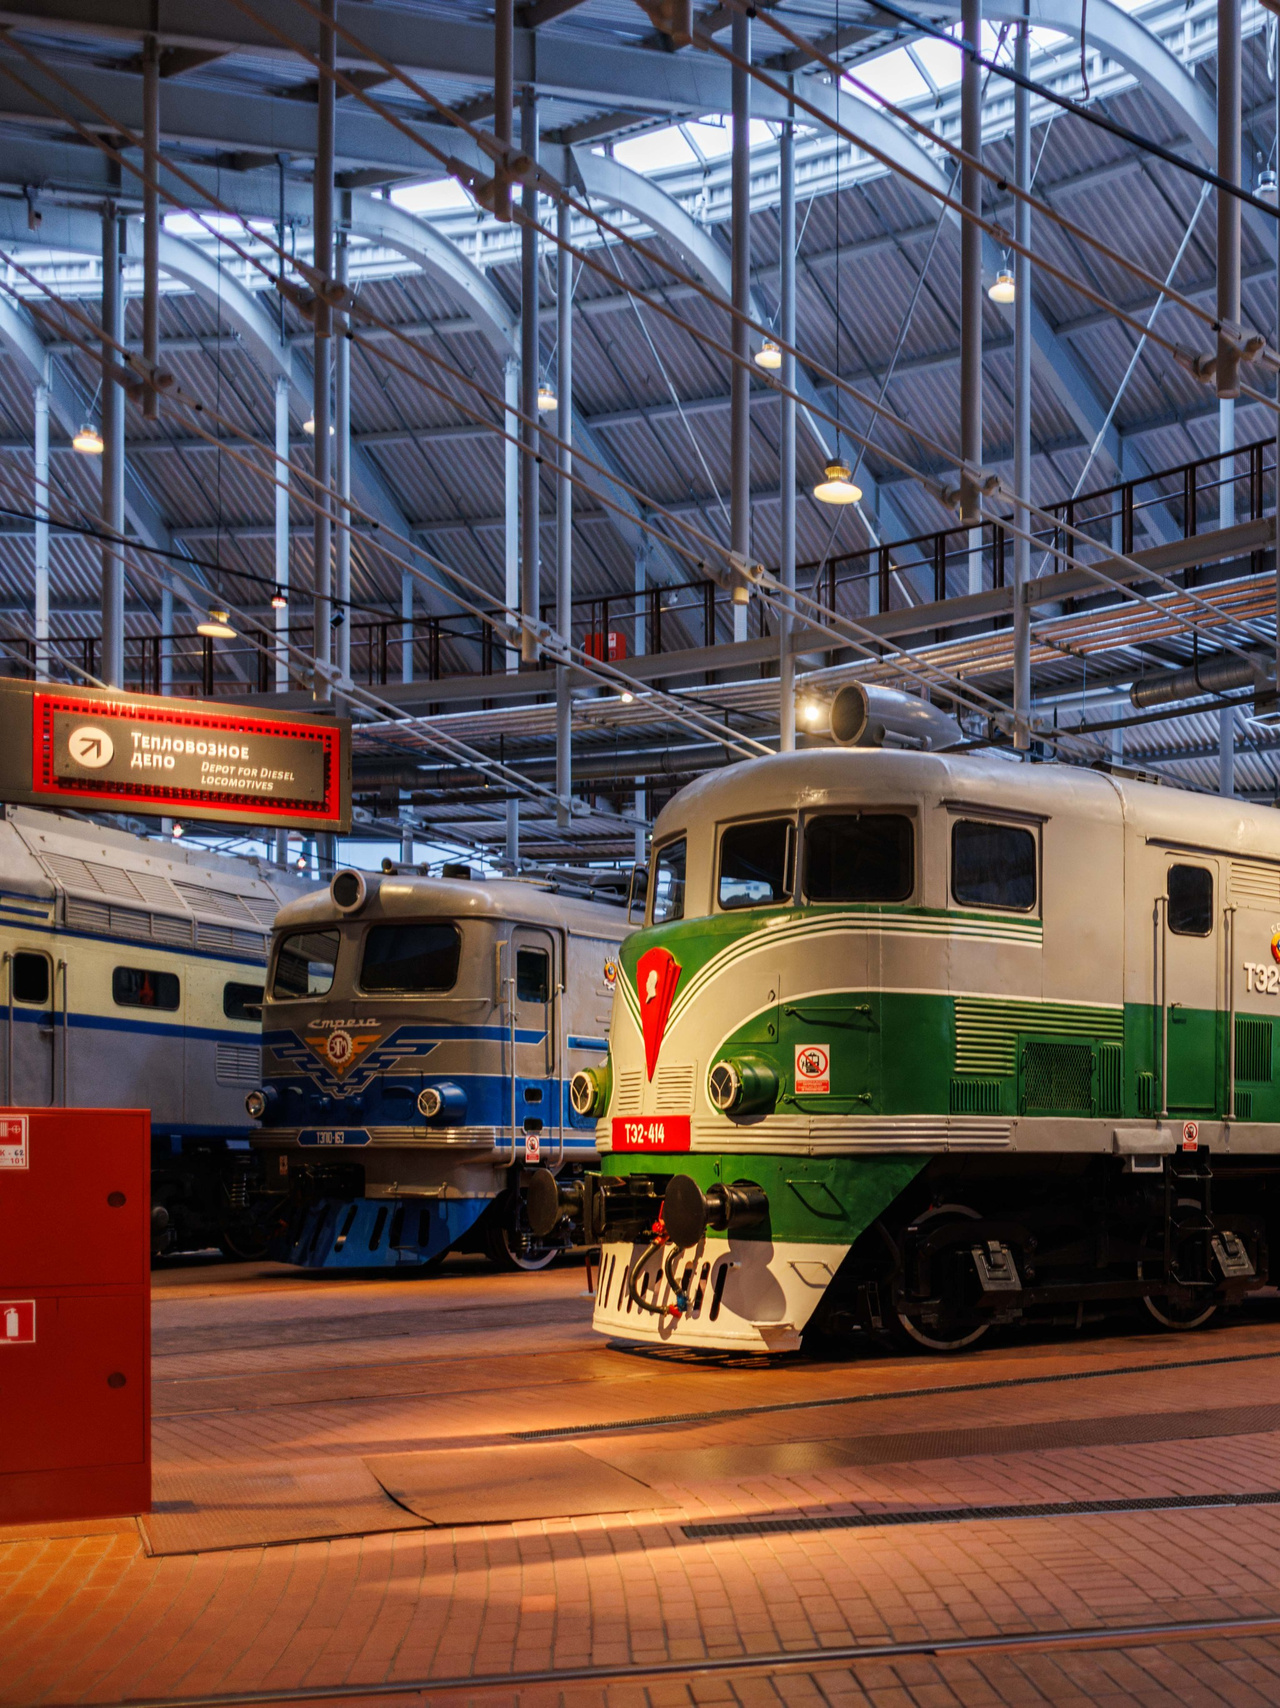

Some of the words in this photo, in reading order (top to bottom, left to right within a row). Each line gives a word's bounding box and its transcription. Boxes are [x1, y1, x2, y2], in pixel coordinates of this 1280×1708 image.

[130, 731, 250, 761] ТЕПЛОВОЗНОЕ
[130, 752, 176, 770] ДЕПО
[201, 761, 236, 775] DEPOT
[238, 766, 258, 779] FOR
[260, 767, 295, 781] DIESEL
[201, 775, 274, 792] LOCOMOTIVES
